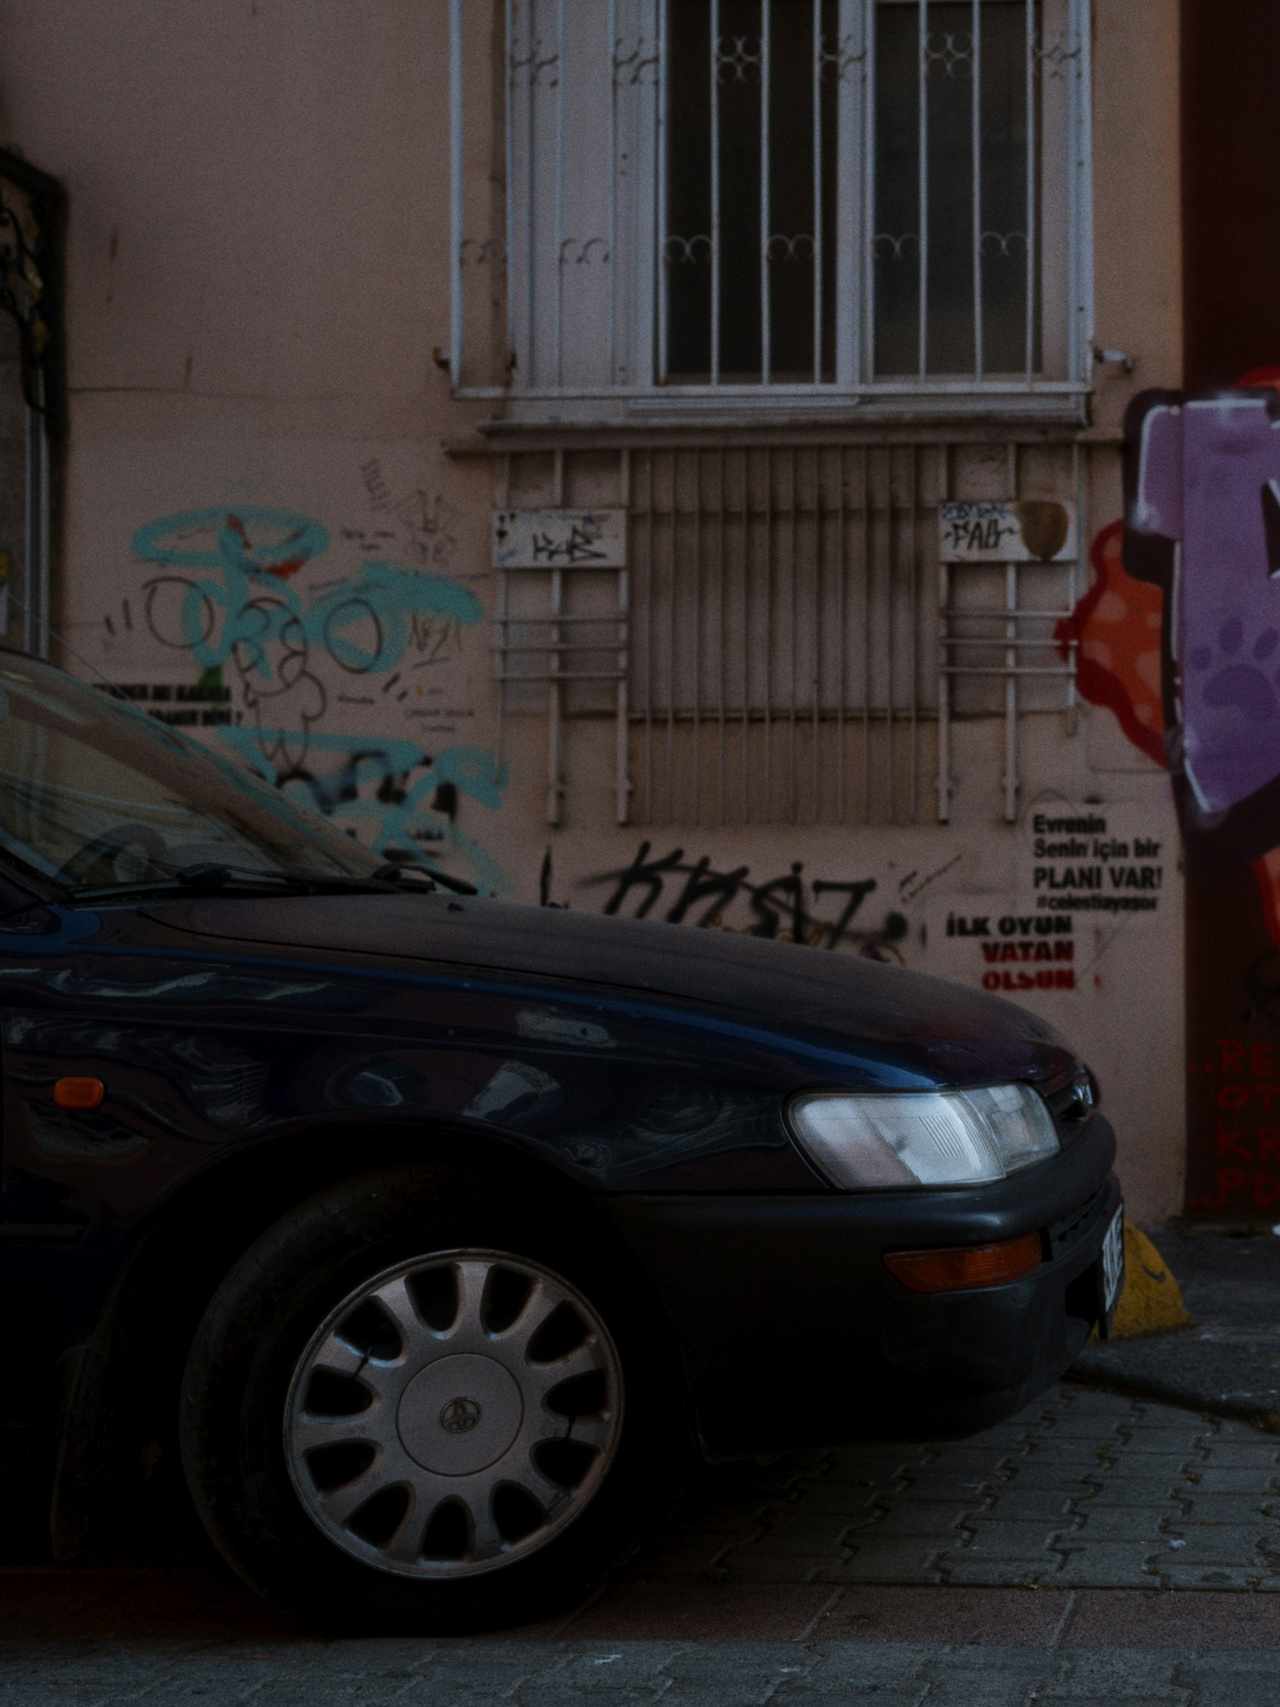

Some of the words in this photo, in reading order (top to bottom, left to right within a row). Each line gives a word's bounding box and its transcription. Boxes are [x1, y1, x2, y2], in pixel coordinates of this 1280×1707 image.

[1033, 814, 1107, 834] Evrenin
[1033, 838, 1088, 858] Senin
[1092, 838, 1129, 862] için
[1134, 838, 1160, 858] bir
[1033, 866, 1102, 889] PLANI
[1109, 866, 1163, 889] VAR!
[946, 911, 990, 937] İLK
[998, 915, 1072, 935] OYUN
[981, 941, 1074, 962] VATAN
[981, 970, 1075, 991] OLSUN
